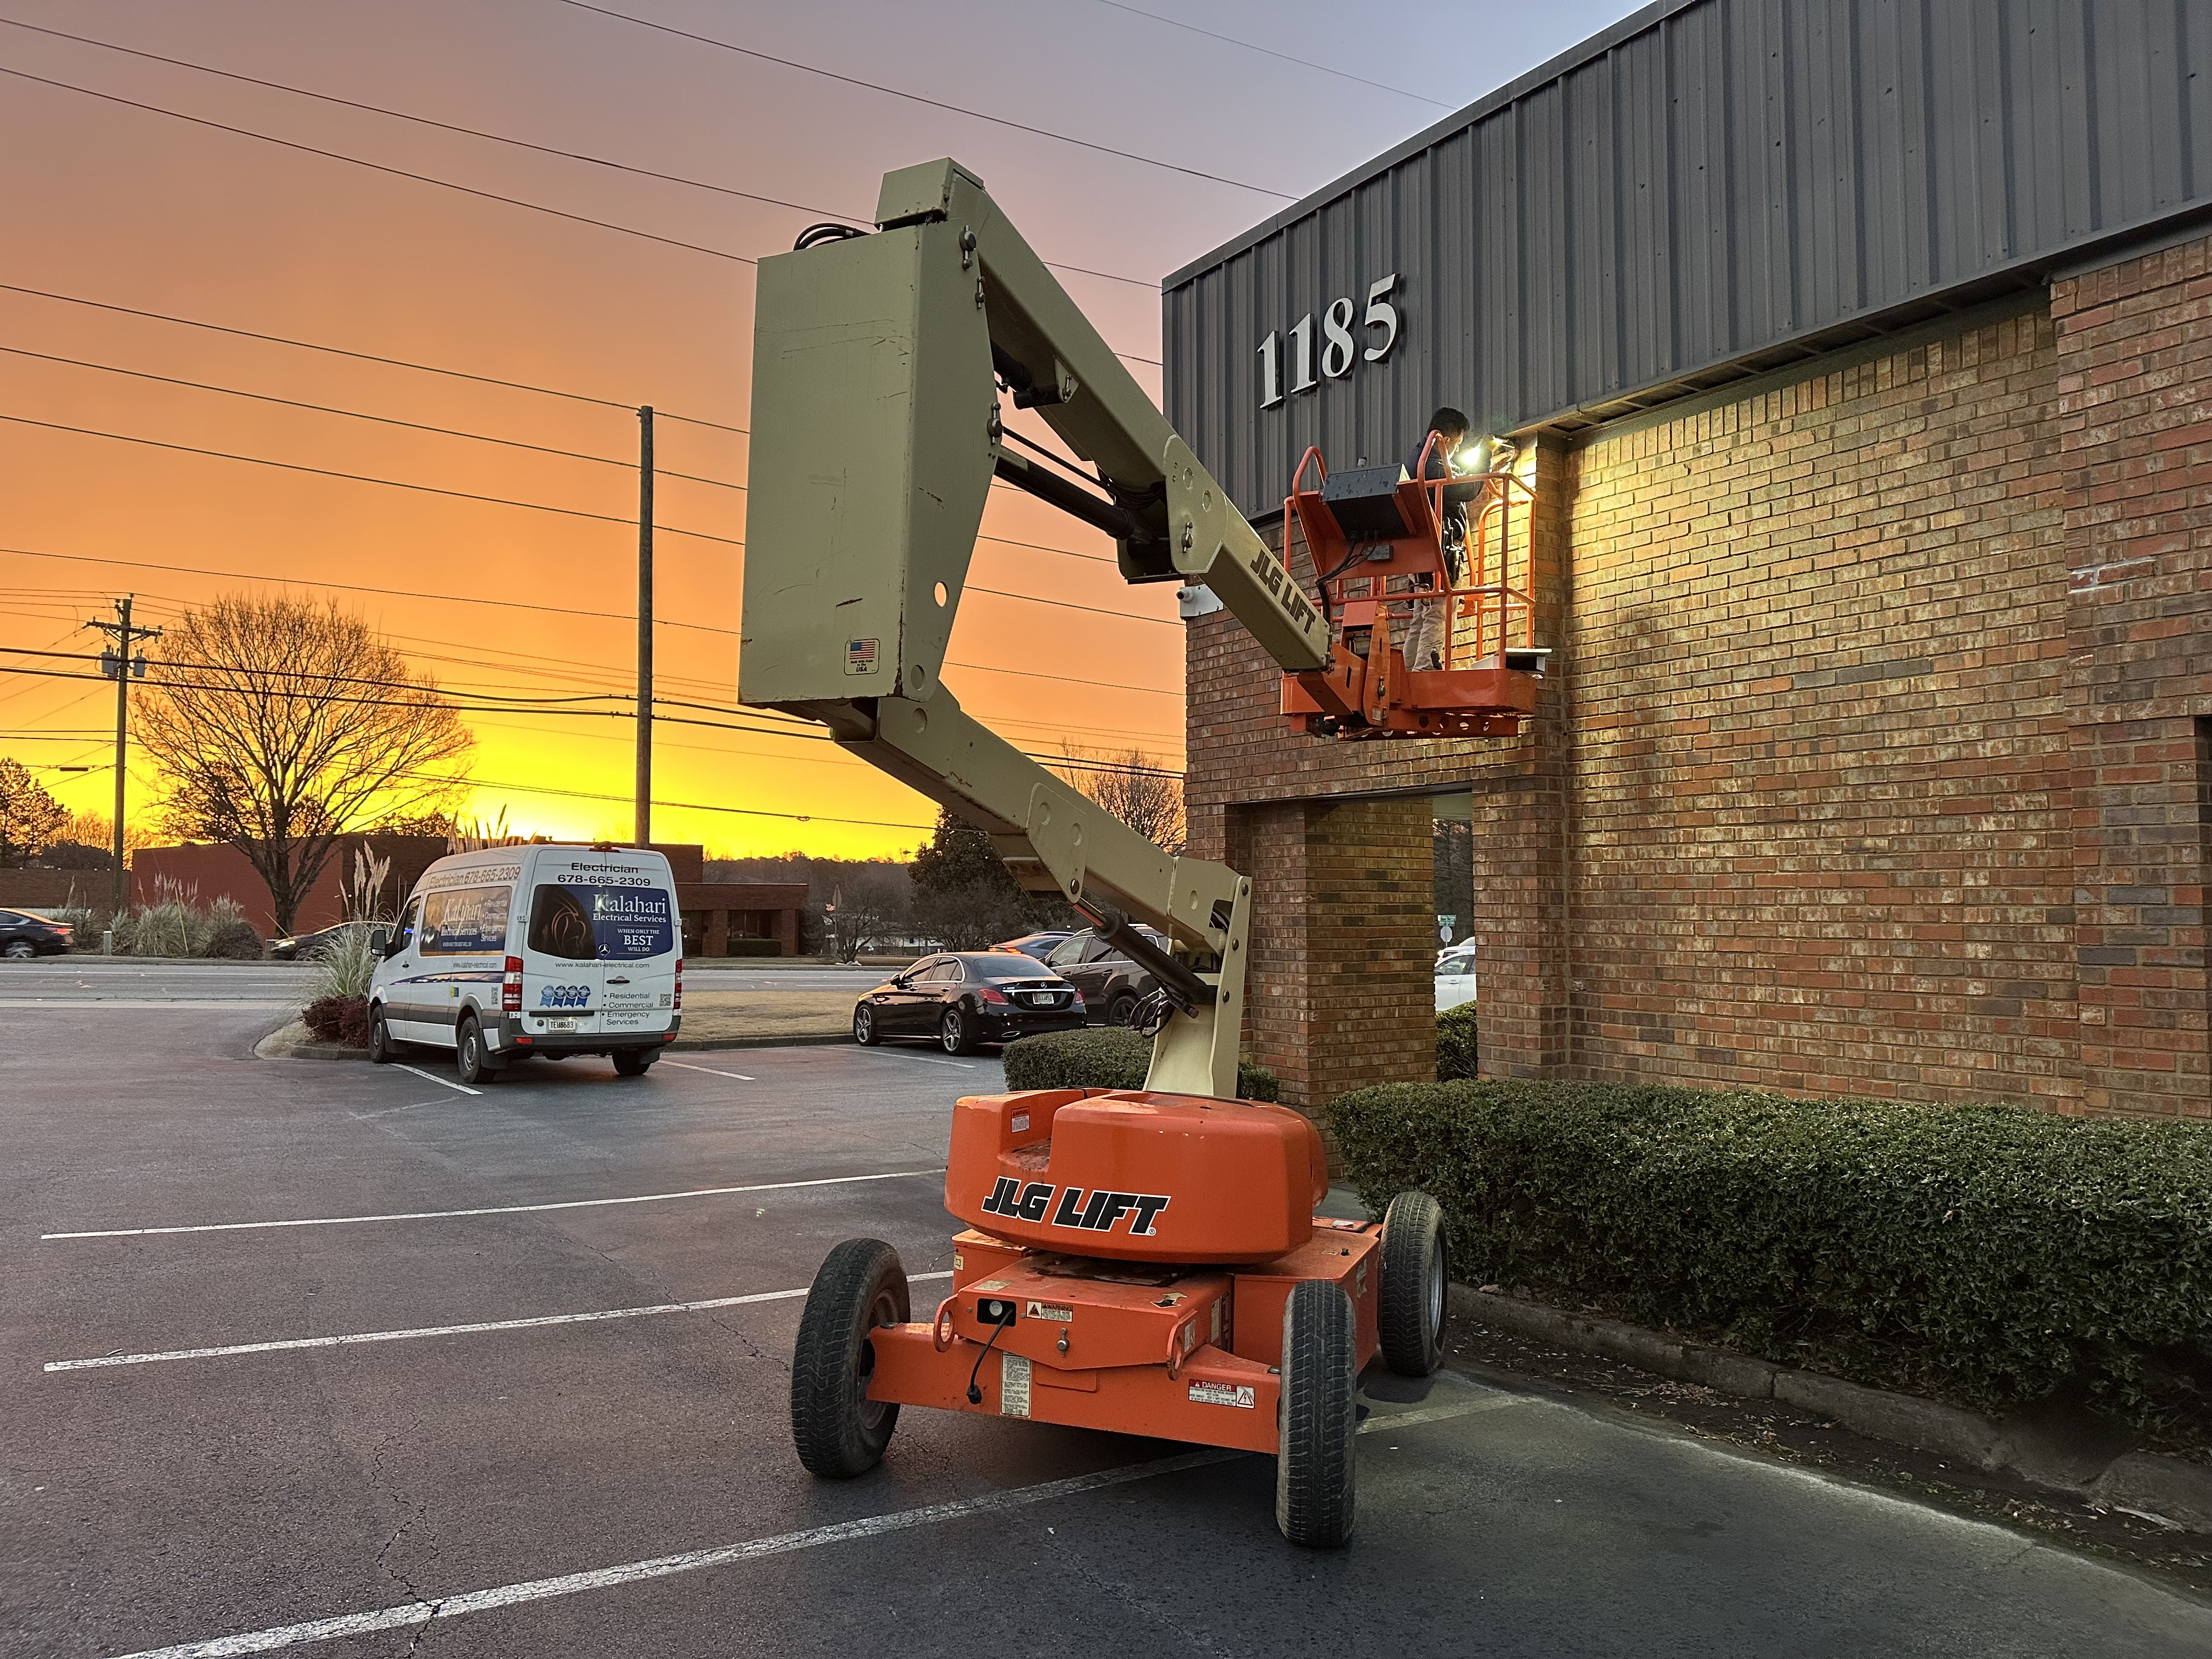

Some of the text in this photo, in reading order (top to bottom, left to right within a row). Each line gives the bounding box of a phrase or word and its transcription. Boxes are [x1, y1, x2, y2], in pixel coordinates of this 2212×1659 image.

[1257, 273, 1397, 409] 1185
[1250, 549, 1316, 635] JLG LIFT
[571, 862, 639, 873] Electrician
[430, 866, 520, 888] Electrician 678-665-2309
[557, 874, 651, 886] 678-665-2309
[443, 897, 483, 922] Kalahari
[593, 894, 666, 914] Kalahari
[592, 913, 667, 923] Electrical Services
[459, 926, 477, 936] Services
[481, 934, 497, 942] Services
[623, 935, 653, 945] BEST
[981, 1176, 1171, 1235] JLG LIFT
[1202, 1381, 1232, 1391] DANGER
